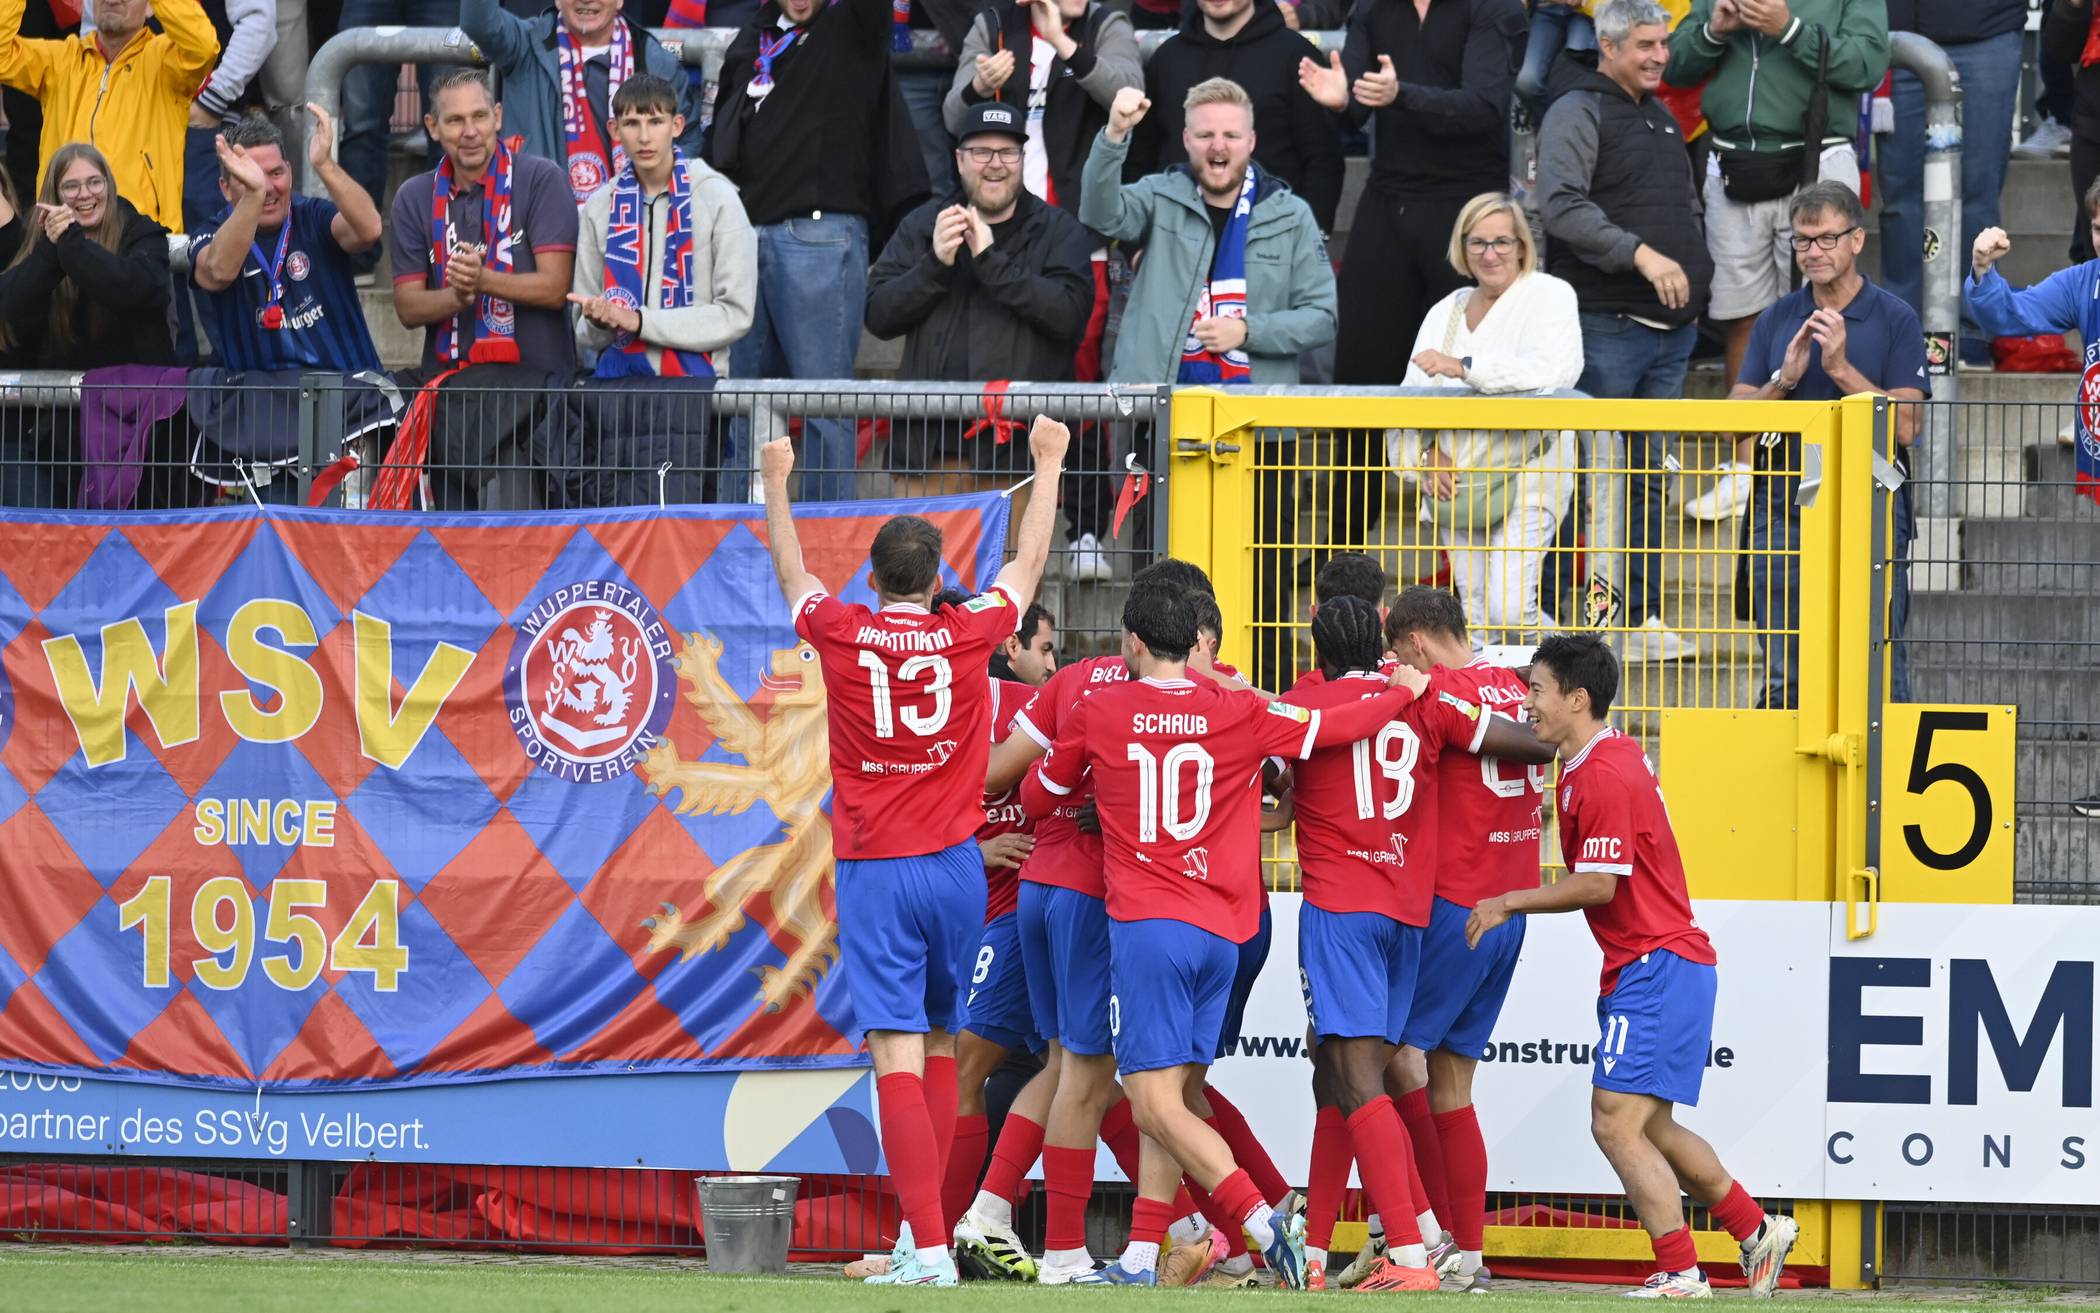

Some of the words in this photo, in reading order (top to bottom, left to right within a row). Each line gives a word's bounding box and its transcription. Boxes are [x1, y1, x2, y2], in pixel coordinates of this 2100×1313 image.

[521, 580, 672, 660] WUPPERTALER
[856, 626, 953, 652] HARTMANN
[41, 599, 477, 771] WSV
[545, 639, 577, 714] WSV
[858, 650, 953, 737] 13
[510, 706, 658, 783] SPORTVEREIN
[1132, 713, 1208, 735] SCHAUB
[861, 760, 885, 774] MSS
[1127, 742, 1215, 843] 10
[1902, 711, 1993, 871] 5
[194, 798, 336, 847] SINCE
[1488, 831, 1510, 843] MSS
[1583, 836, 1622, 860] MTC
[119, 876, 408, 992] 1954
[972, 945, 995, 984] 8
[1603, 1015, 1630, 1055] 11
[1827, 956, 2095, 1109] EM
[120, 1108, 183, 1145] des
[194, 1109, 289, 1155] SSVg
[301, 1112, 430, 1150] Velbert.
